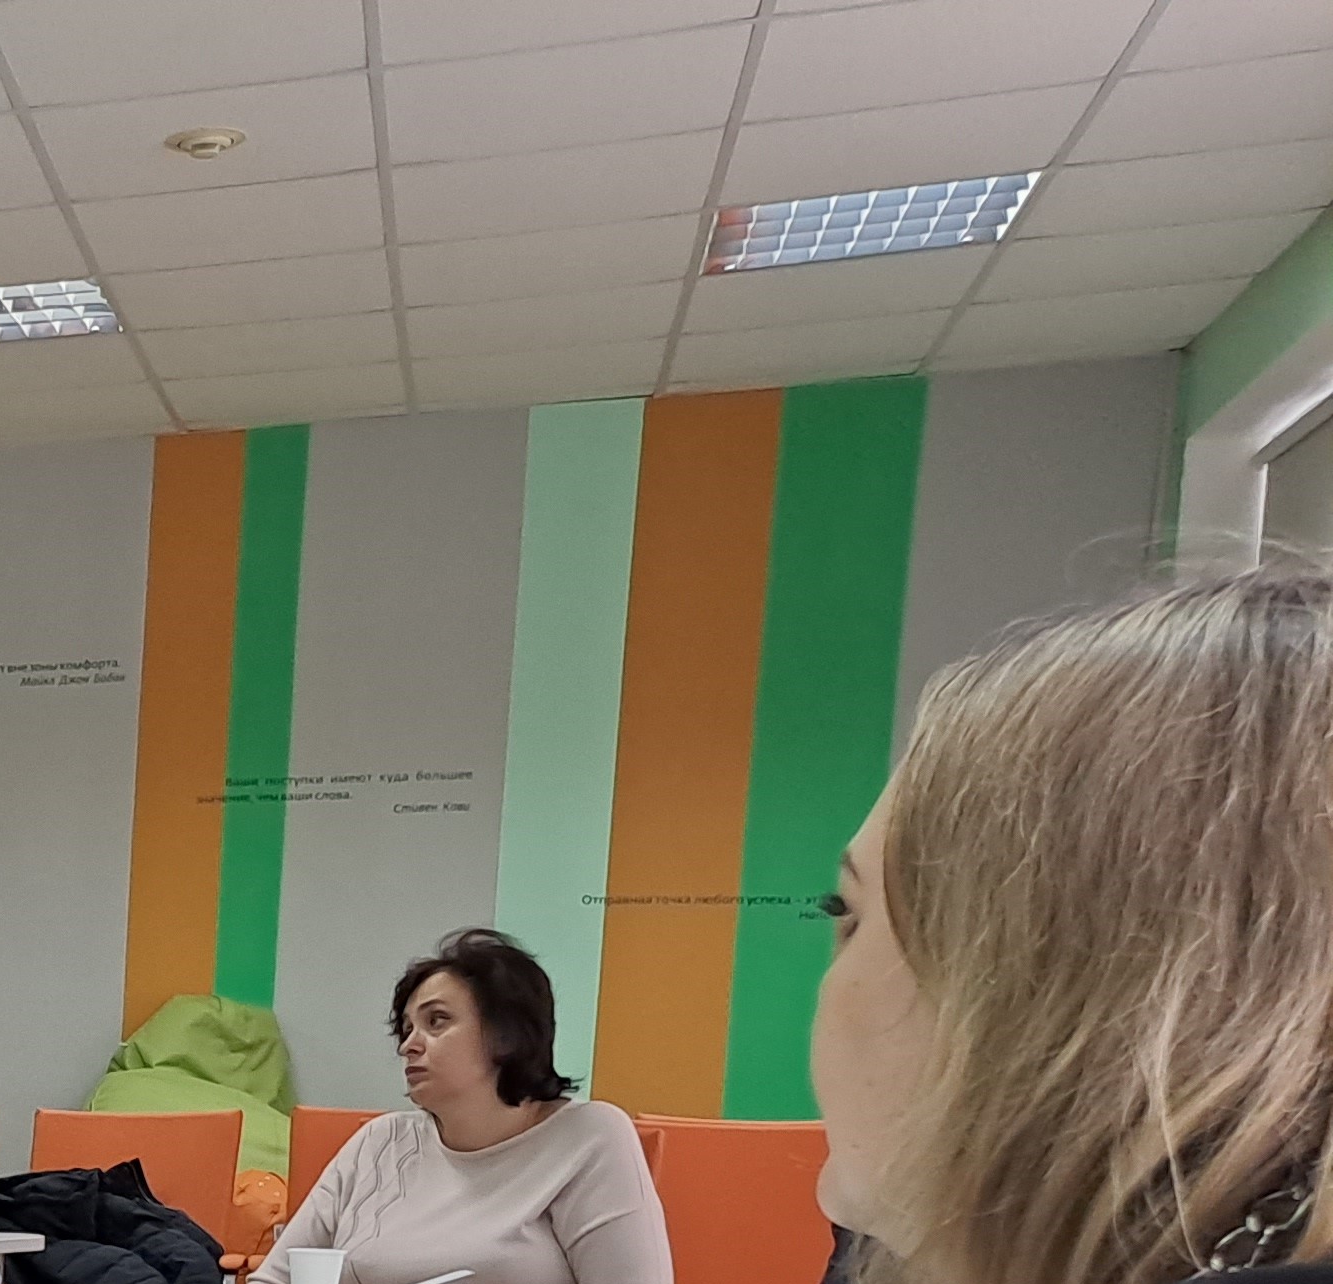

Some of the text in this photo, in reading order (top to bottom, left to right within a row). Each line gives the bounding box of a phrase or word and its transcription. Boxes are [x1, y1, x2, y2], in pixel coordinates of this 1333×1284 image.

[264, 774, 324, 789] поступки
[329, 773, 373, 785] имеют
[378, 772, 409, 786] куда
[415, 768, 474, 782] большее
[281, 790, 313, 802] ваши
[393, 801, 471, 814] Стивен Кови
[581, 893, 653, 907] Отправная
[654, 895, 691, 906] точка
[693, 893, 745, 906] любого
[746, 894, 792, 908] успеха
